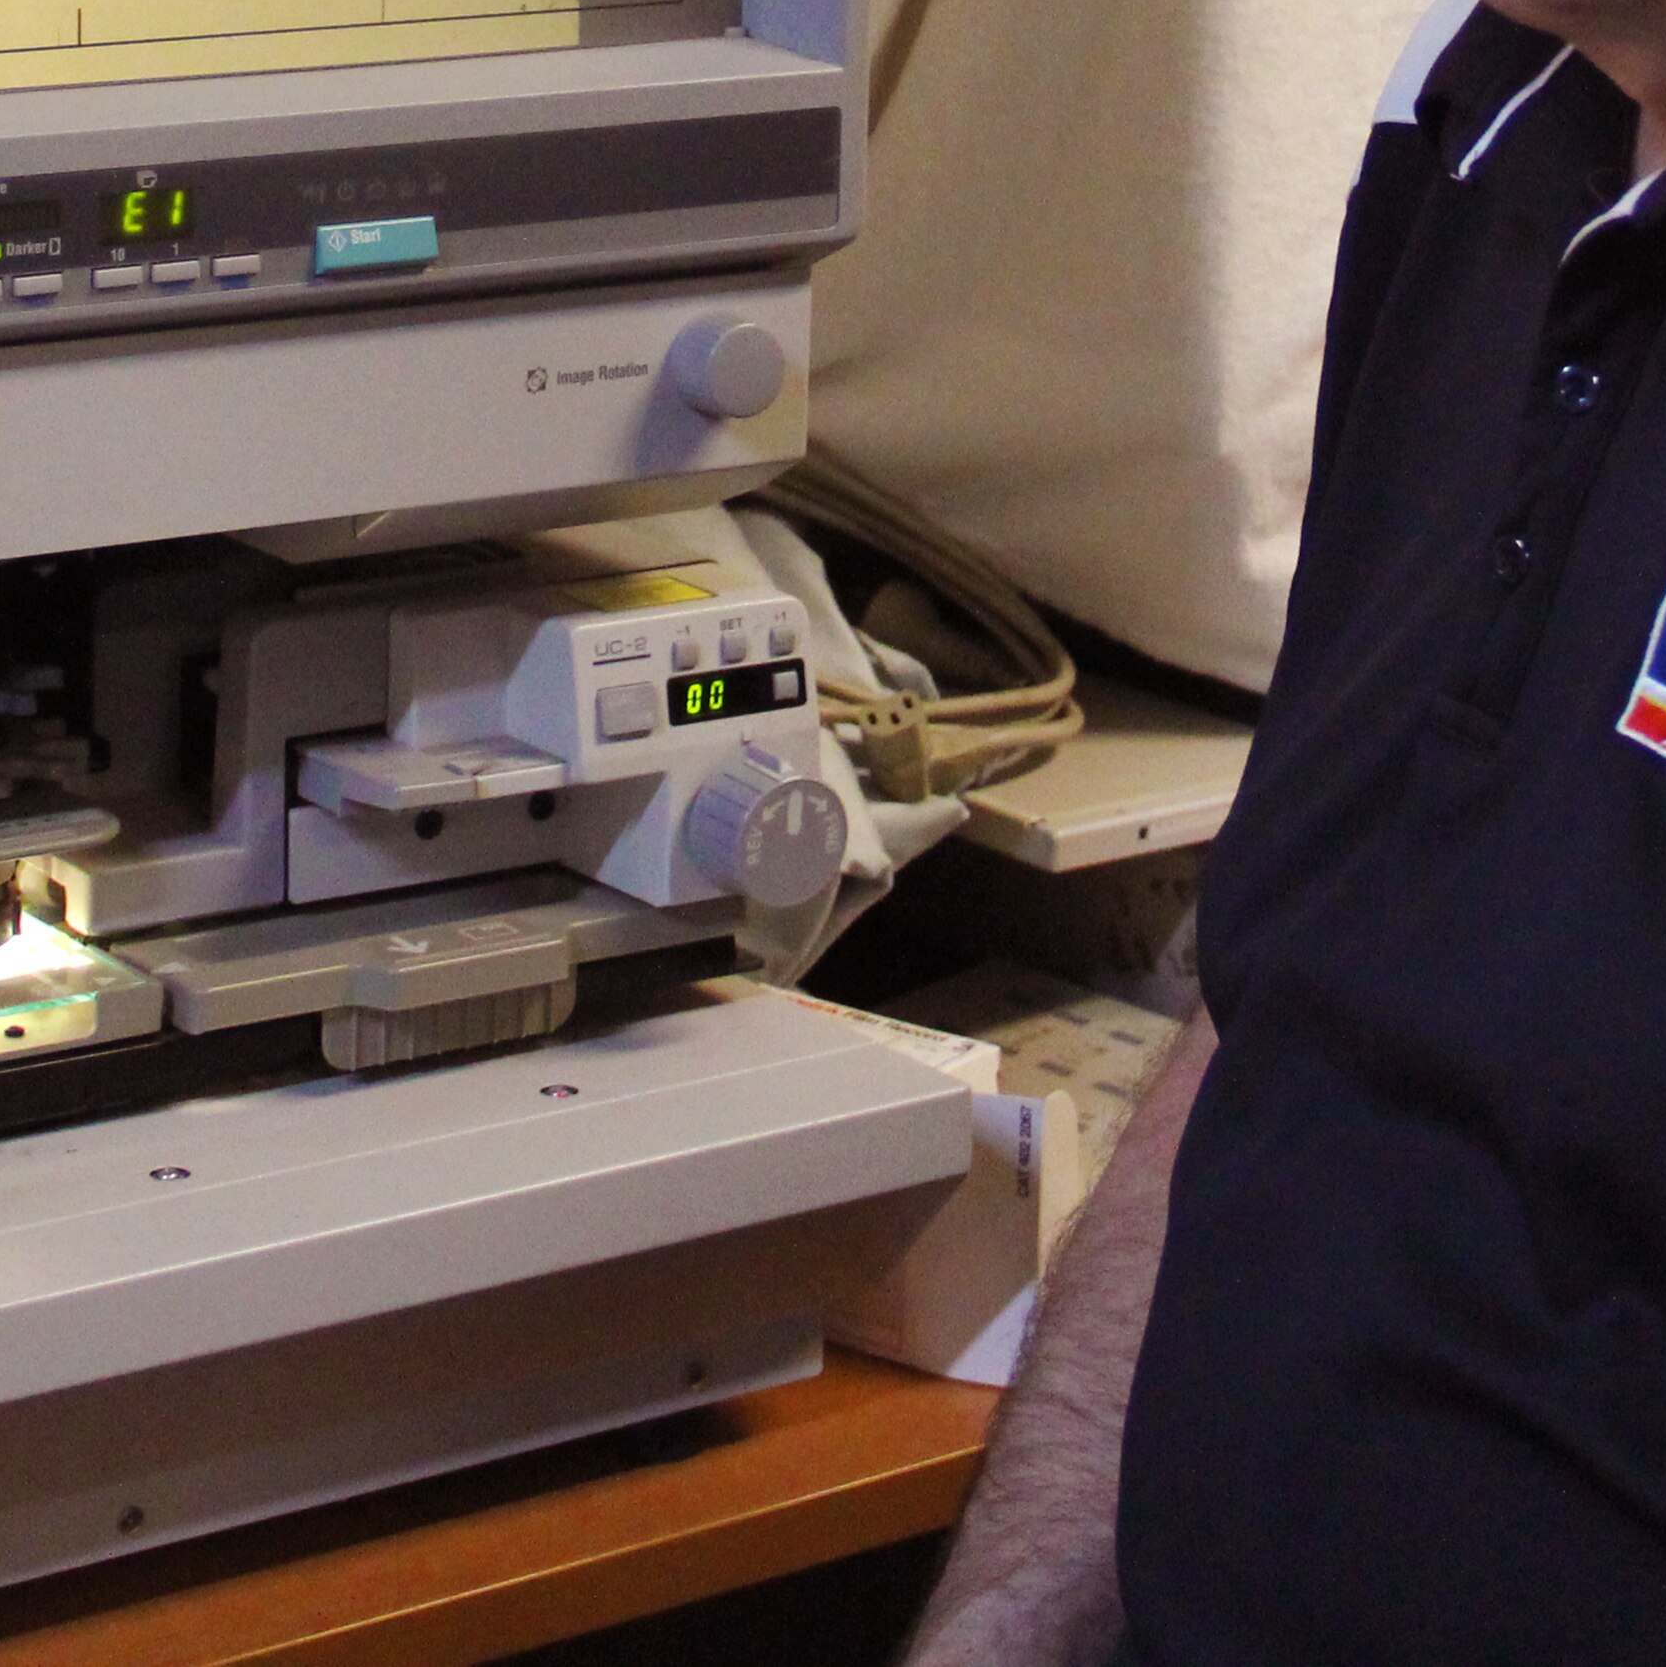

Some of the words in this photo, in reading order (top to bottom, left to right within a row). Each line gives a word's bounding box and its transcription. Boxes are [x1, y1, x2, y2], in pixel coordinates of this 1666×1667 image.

[351, 230, 382, 246] Start
[6, 240, 47, 257] Darker
[110, 248, 126, 262] 10
[171, 242, 180, 256] 1
[556, 369, 595, 386] Image
[598, 363, 649, 381] Rotation
[719, 617, 743, 632] SET
[686, 679, 725, 714] 00
